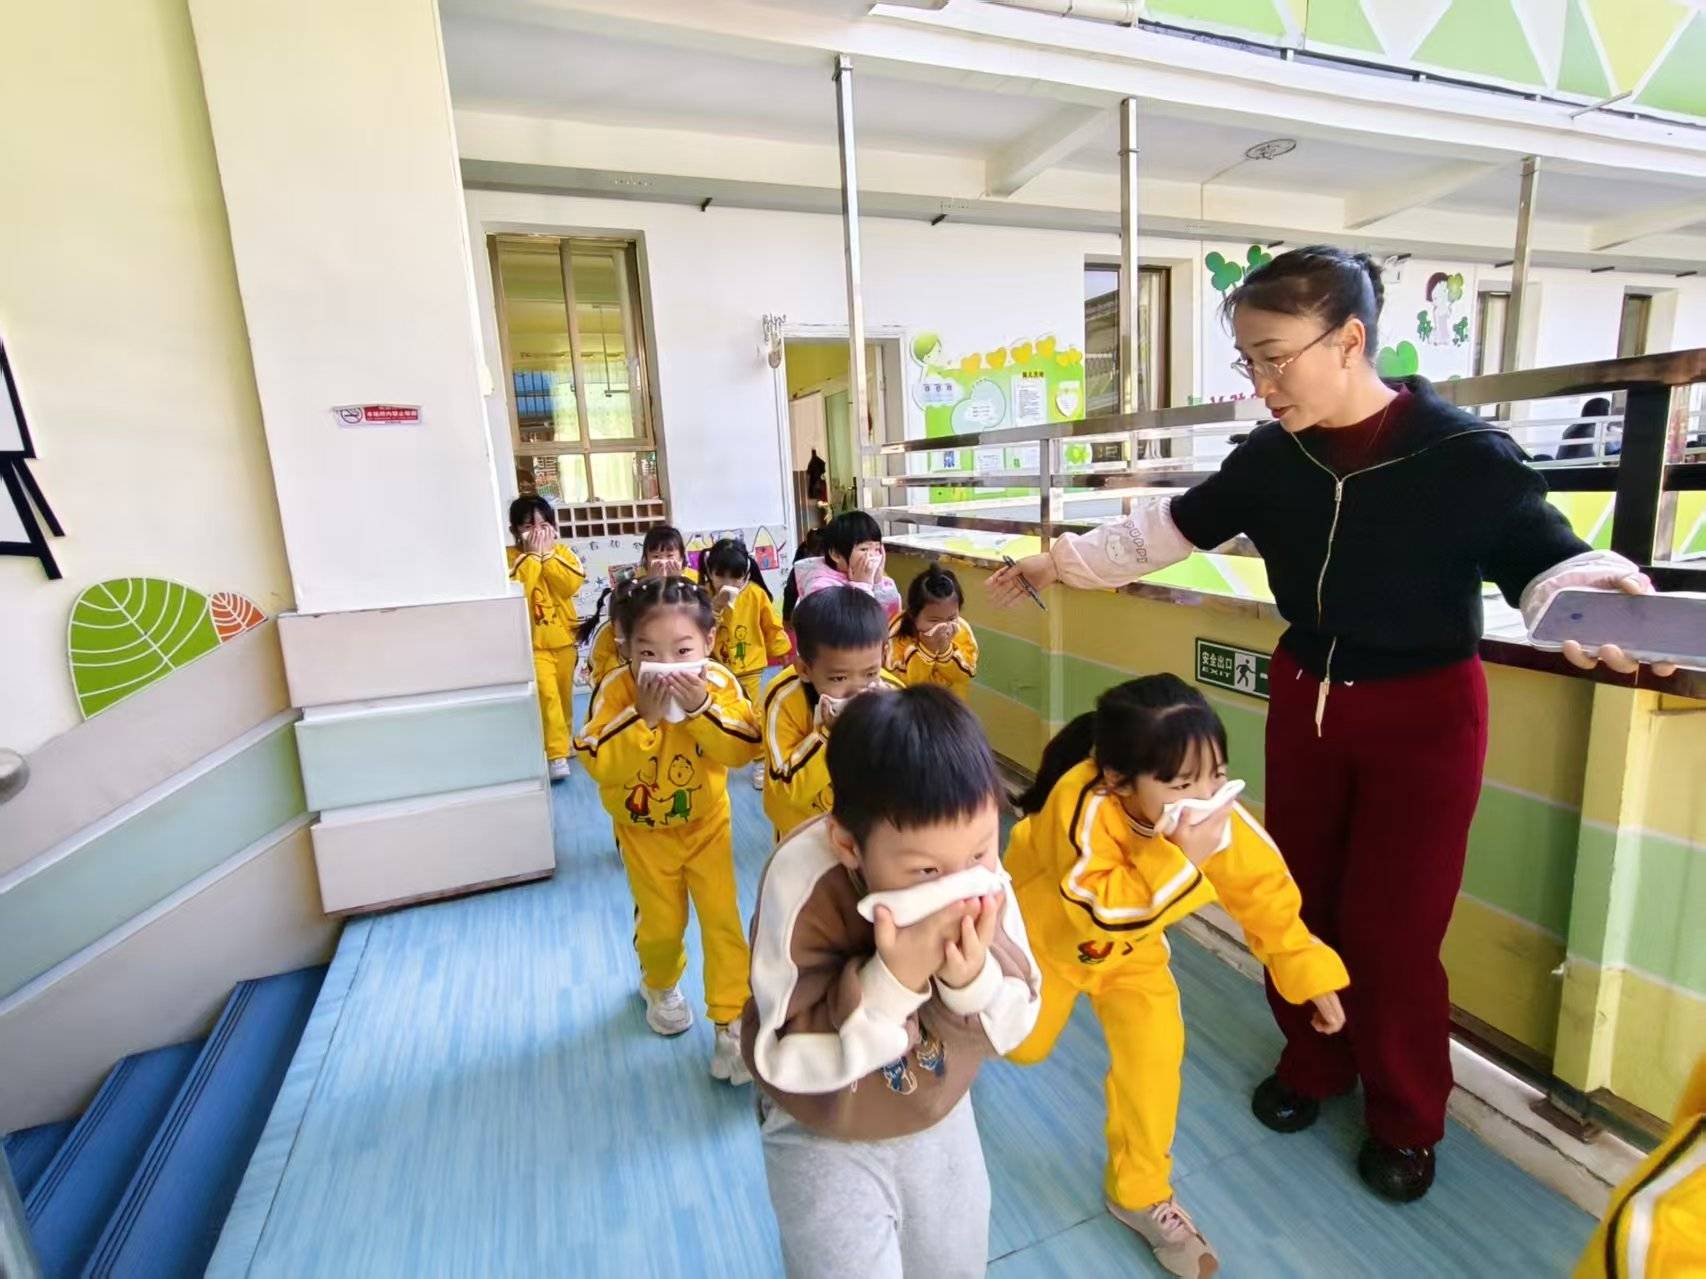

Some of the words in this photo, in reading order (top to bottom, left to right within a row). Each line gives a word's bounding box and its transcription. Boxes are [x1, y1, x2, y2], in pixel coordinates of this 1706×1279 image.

[1201, 651, 1233, 669] 安全出口
[1201, 666, 1232, 678] EXIT
